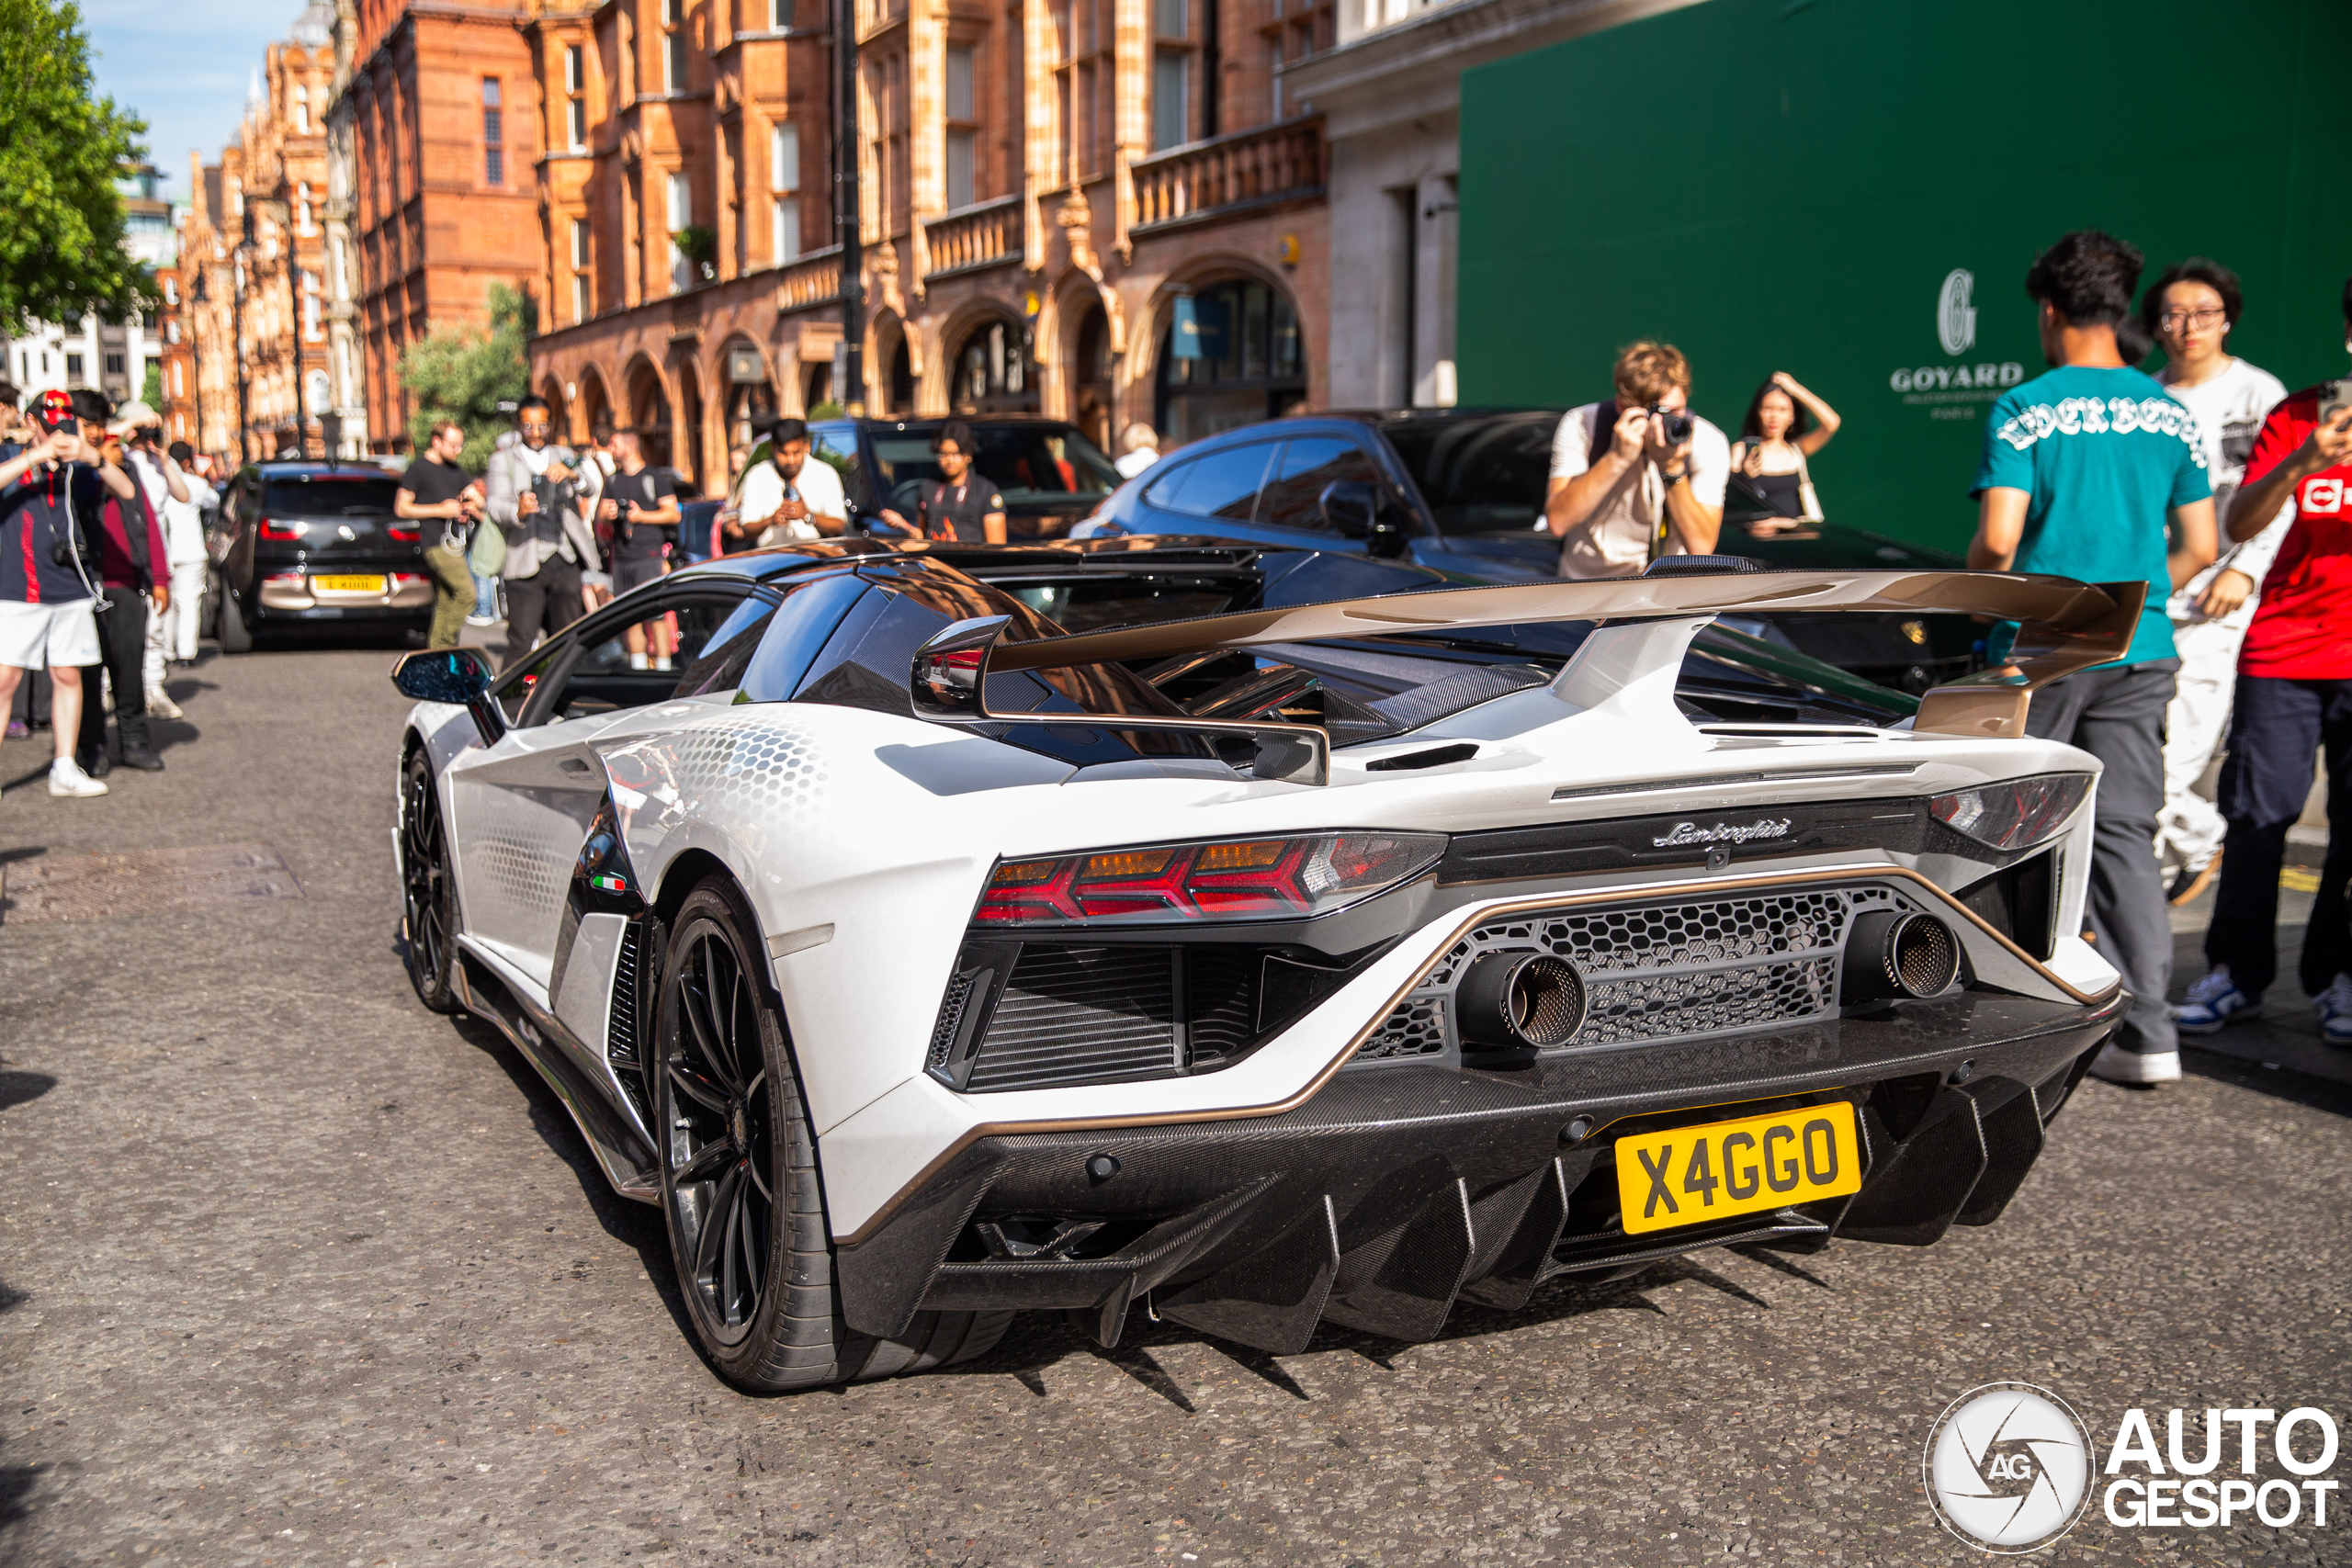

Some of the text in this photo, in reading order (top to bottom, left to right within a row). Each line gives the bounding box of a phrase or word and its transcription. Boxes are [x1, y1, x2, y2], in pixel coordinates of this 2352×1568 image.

[1890, 361, 2025, 393] GOYARD
[1652, 818, 1792, 848] Lamborghini
[1636, 1118, 1838, 1219] X4GGO
